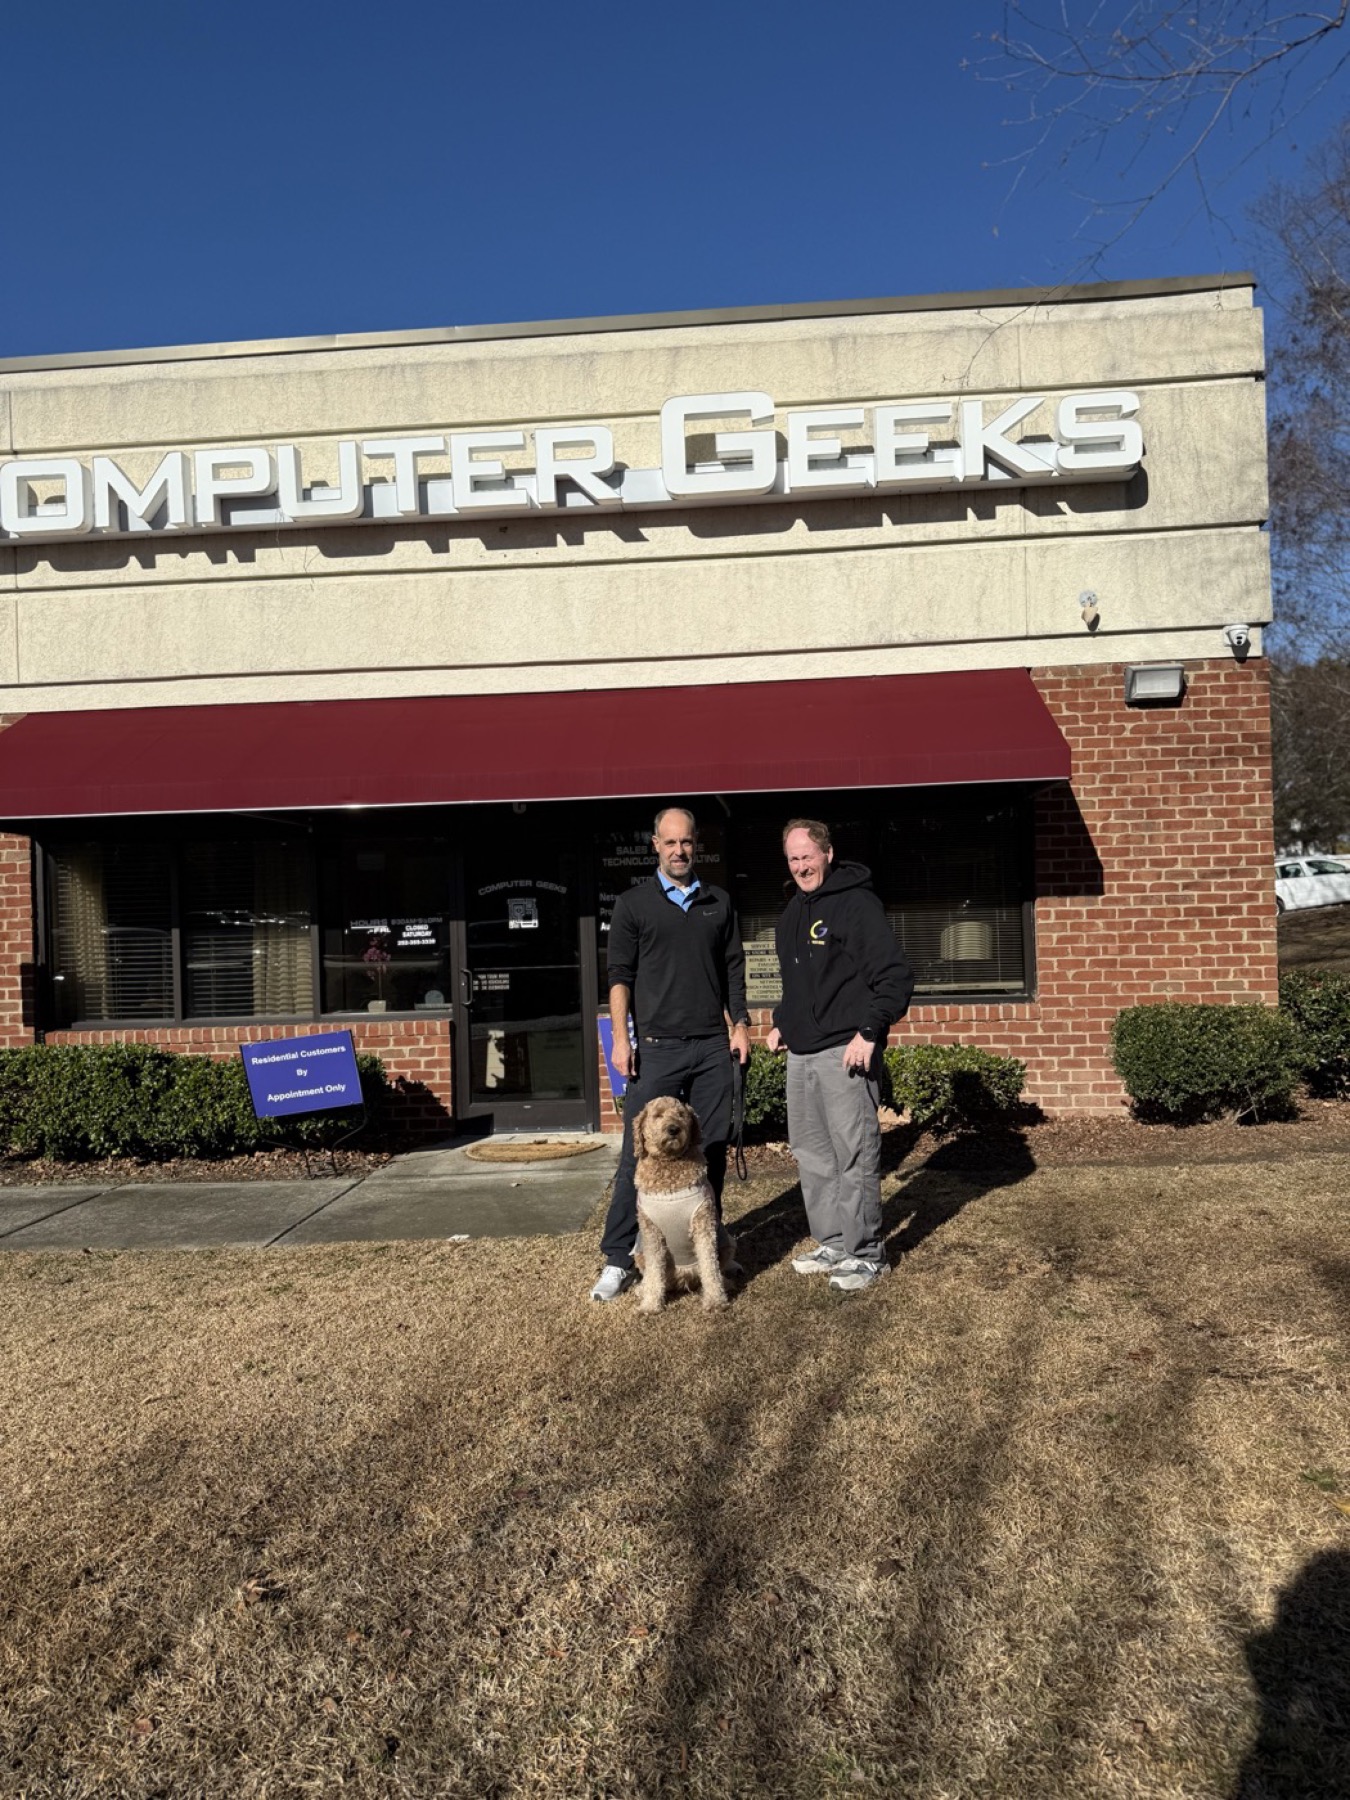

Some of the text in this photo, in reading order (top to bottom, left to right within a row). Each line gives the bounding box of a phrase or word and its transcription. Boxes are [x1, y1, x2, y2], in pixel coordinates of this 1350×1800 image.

[660, 391, 1144, 499] GEEKS
[616, 845, 648, 855] SALES
[478, 880, 567, 895] COMPUTER GEEKS
[402, 930, 433, 938] SATURDAY
[405, 924, 429, 932] CLOSED
[251, 1046, 346, 1065] Residential Customers
[296, 1068, 308, 1077] By
[267, 1083, 346, 1102] Appointment Only
